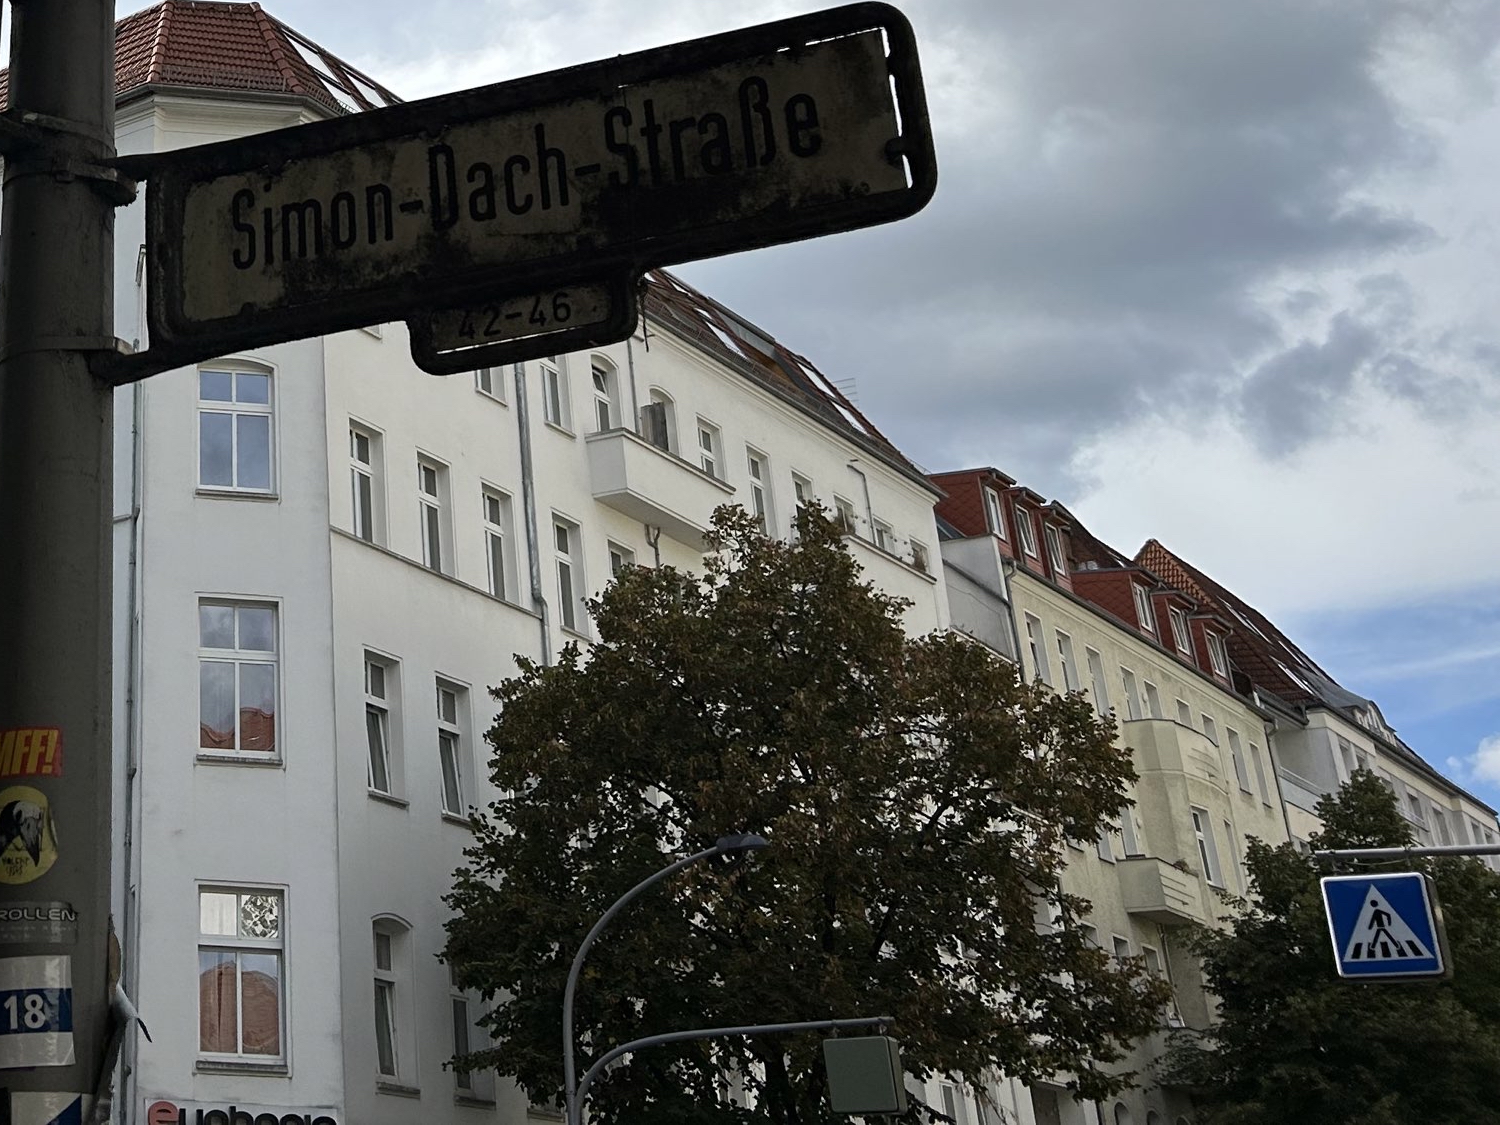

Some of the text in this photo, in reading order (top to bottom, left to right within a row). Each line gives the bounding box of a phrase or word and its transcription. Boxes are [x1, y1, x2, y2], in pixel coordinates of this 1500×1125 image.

[231, 75, 822, 271] Simon-Dach-Straße
[456, 292, 574, 341] 42-46
[4, 994, 47, 1031] 18
